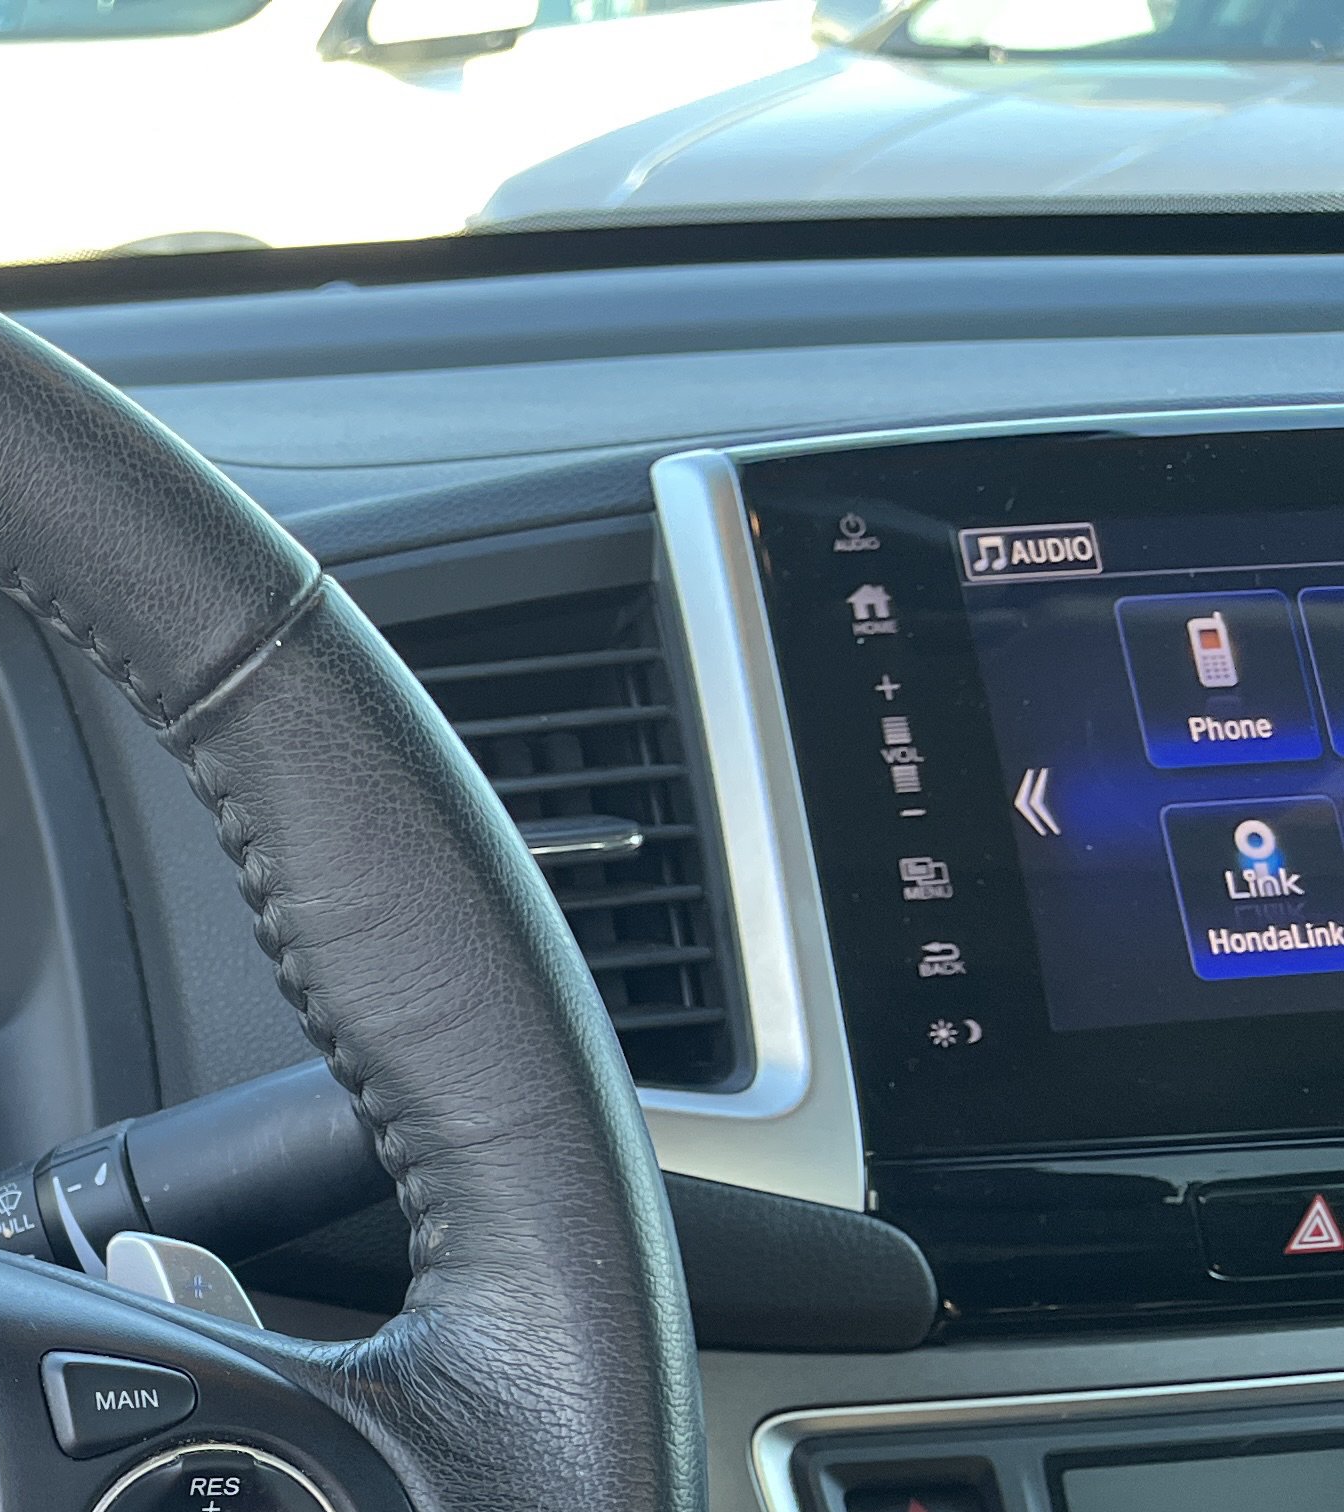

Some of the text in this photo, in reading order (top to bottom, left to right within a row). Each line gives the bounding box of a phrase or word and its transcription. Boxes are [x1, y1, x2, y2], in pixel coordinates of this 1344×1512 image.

[1011, 536, 1093, 565] AUDIO
[1188, 715, 1274, 744] Phone
[881, 748, 924, 764] VOL
[1224, 867, 1306, 901] Link
[1207, 920, 1344, 956] HondaLink
[94, 1388, 160, 1411] MAIN
[188, 1476, 241, 1497] RES
